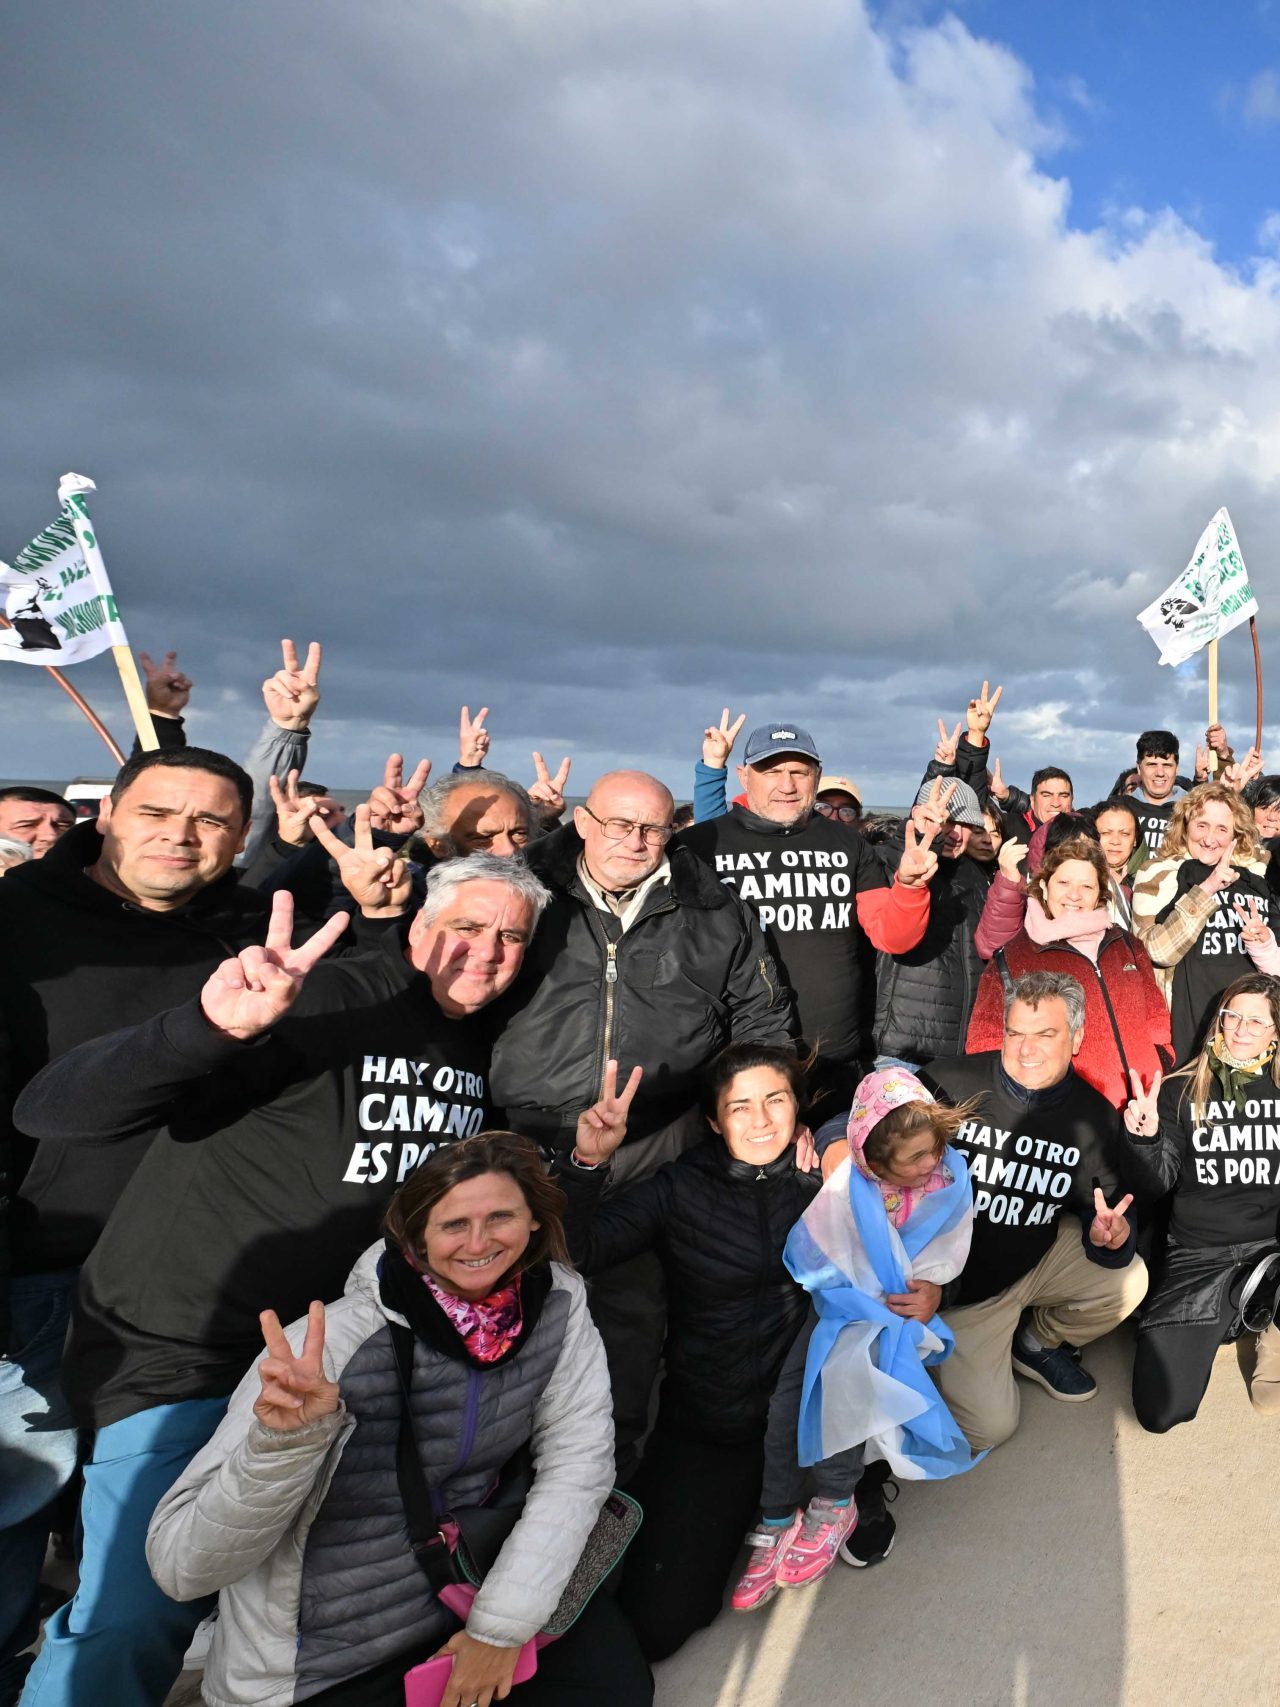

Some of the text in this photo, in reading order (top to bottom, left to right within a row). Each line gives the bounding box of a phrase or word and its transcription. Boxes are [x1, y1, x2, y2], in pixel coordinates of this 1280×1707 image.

[715, 850, 849, 872] HAY OTRO
[1211, 890, 1230, 906] AY
[758, 902, 852, 932] POR AK
[1201, 931, 1248, 955] ES PO
[361, 1055, 484, 1099] HAY OTRO
[1190, 1100, 1237, 1121] HAY
[956, 1121, 1081, 1167] HAY OTRO
[341, 1142, 450, 1184] ES PO
[1194, 1157, 1219, 1185] ES
[1224, 1157, 1271, 1185] POR
[973, 1189, 1063, 1227] POR AK
